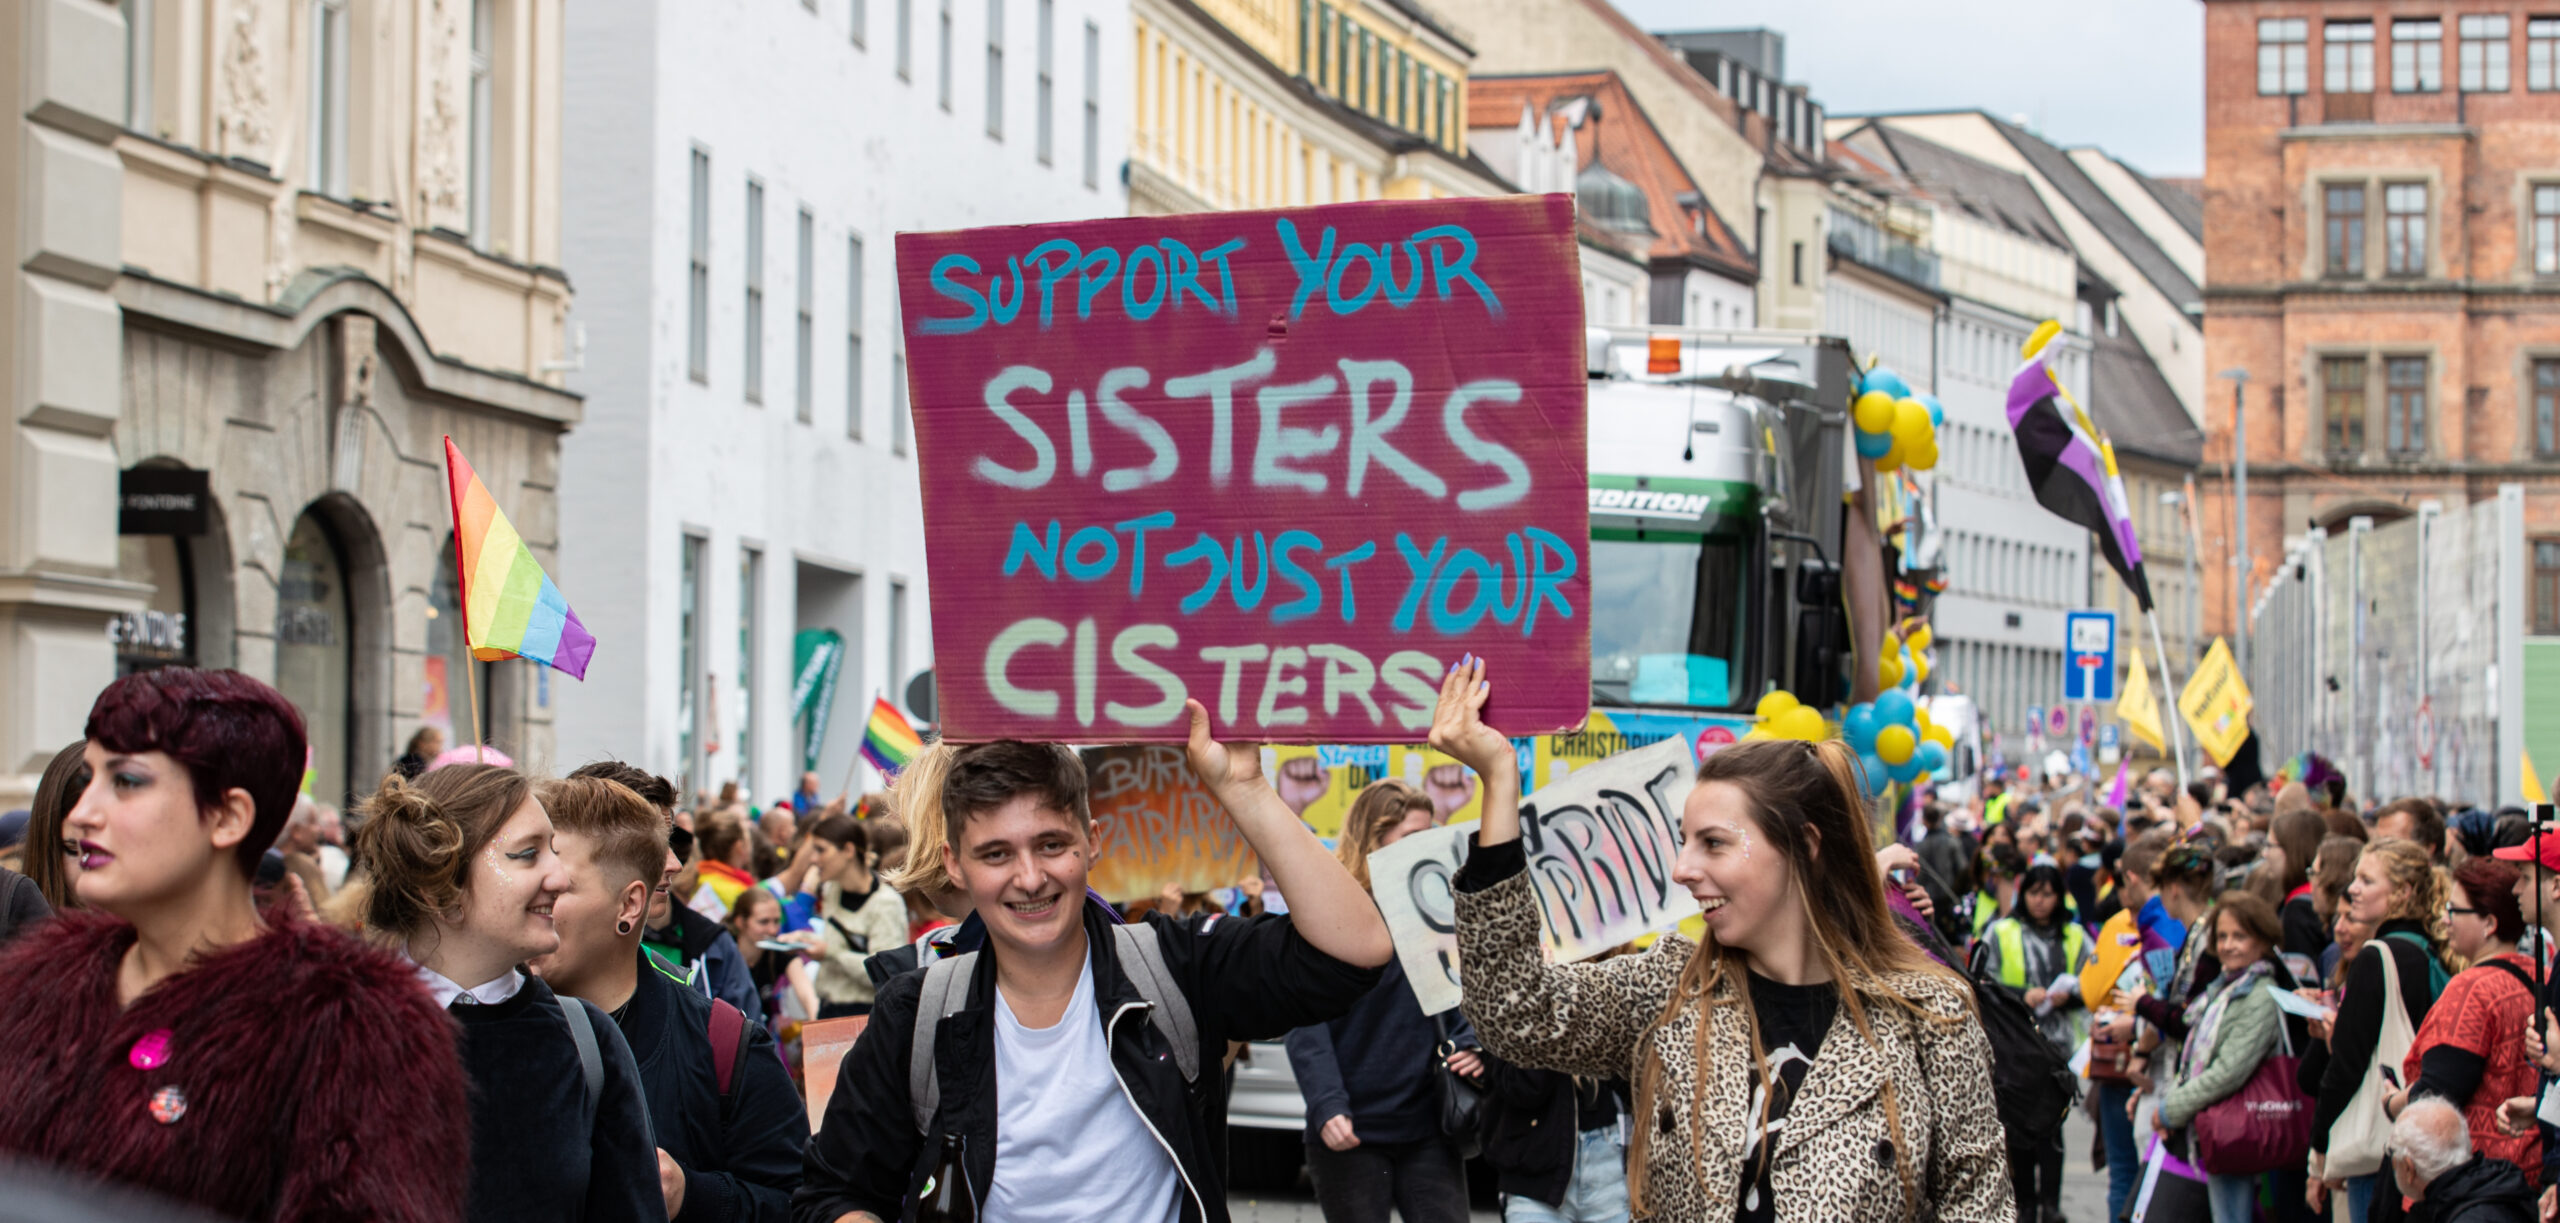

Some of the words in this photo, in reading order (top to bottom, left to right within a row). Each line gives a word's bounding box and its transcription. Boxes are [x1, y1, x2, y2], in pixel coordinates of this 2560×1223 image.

[915, 237, 1247, 335] SUPPORT
[1276, 218, 1506, 323] YOUR
[974, 347, 1533, 512] SISTERS
[1001, 511, 1177, 600] NOT
[1164, 530, 1378, 626] JUST
[1390, 525, 1579, 638] YOUR
[984, 617, 1446, 730] CISTERS
